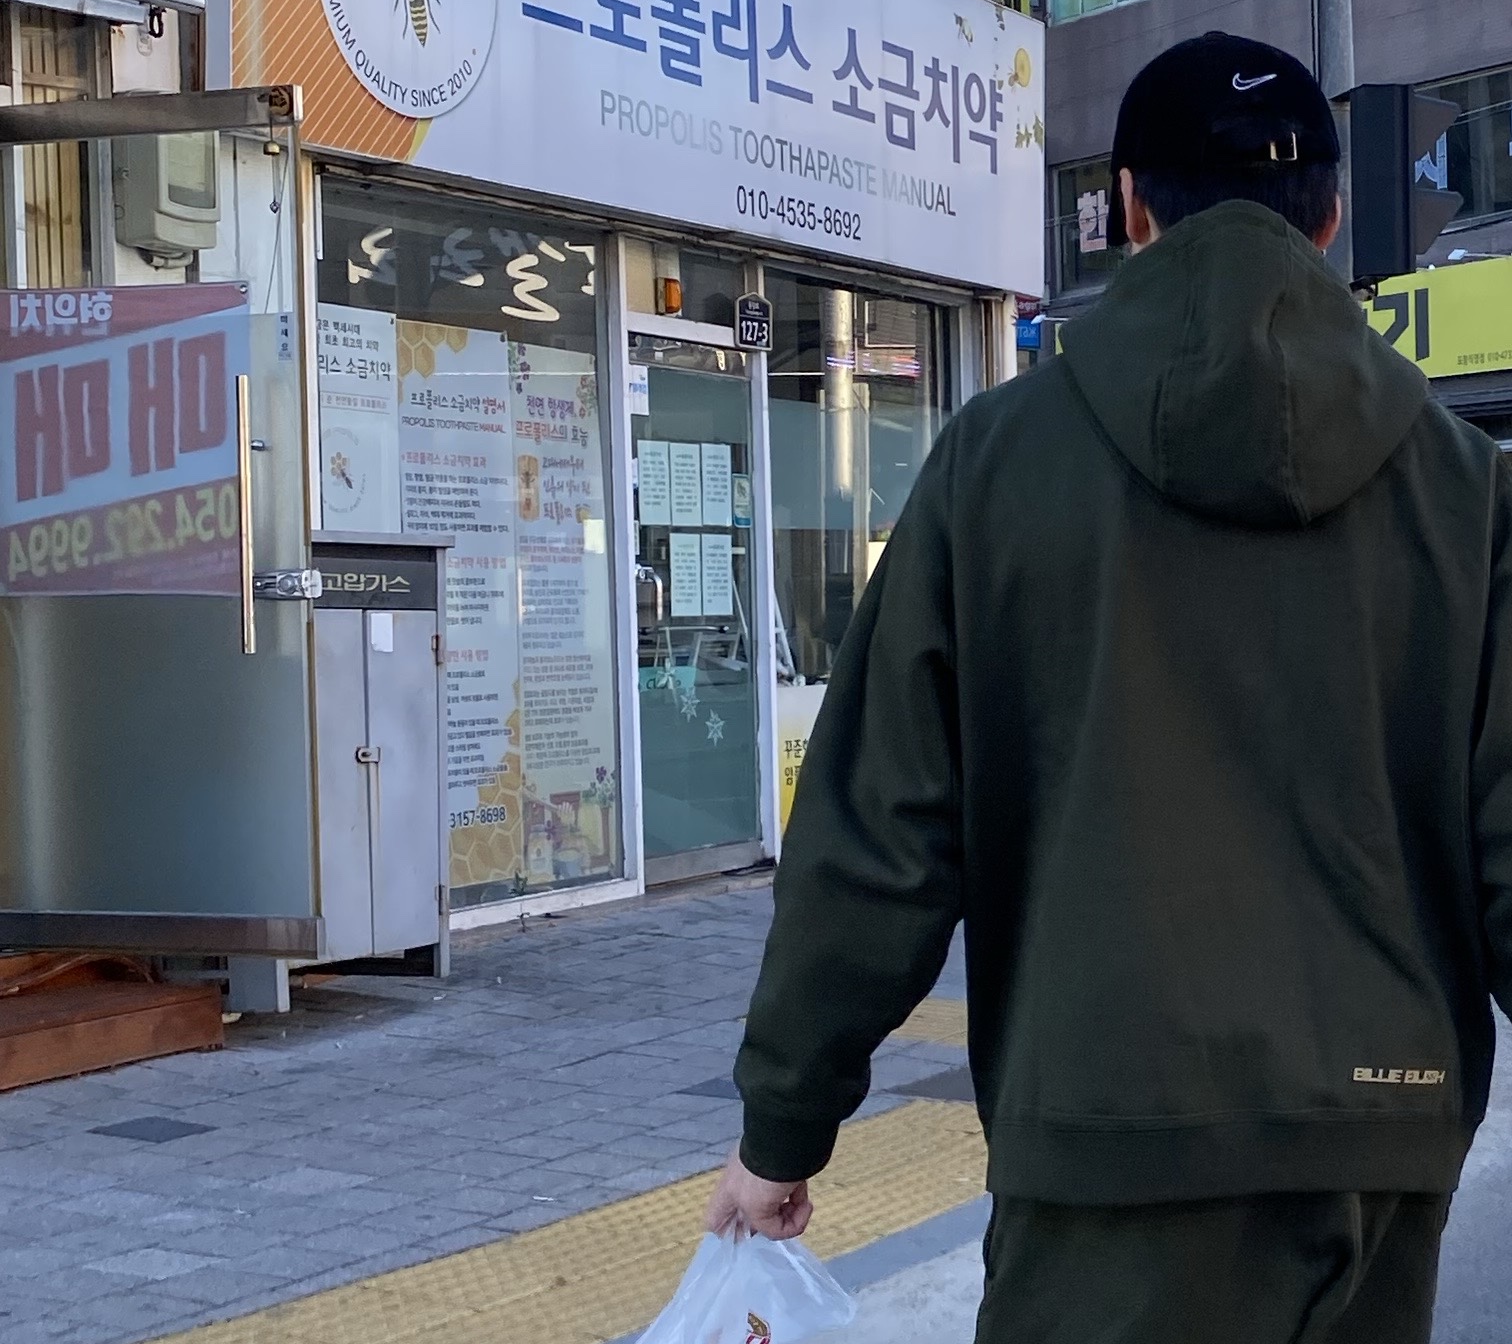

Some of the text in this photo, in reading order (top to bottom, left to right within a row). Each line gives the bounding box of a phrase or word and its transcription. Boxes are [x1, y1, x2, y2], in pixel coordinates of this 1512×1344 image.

[354, 48, 408, 105] QUALITY
[410, 87, 447, 109] SINCE
[446, 58, 474, 97] 2010
[831, 27, 1004, 175] 소금치약
[599, 88, 957, 217] PROPOLIS TOOTHAPASTE MANUAL
[736, 184, 863, 243] 010-4535-8692
[741, 320, 769, 343] 127-3
[345, 357, 391, 381] 소금치약
[322, 572, 411, 594] 고압가스
